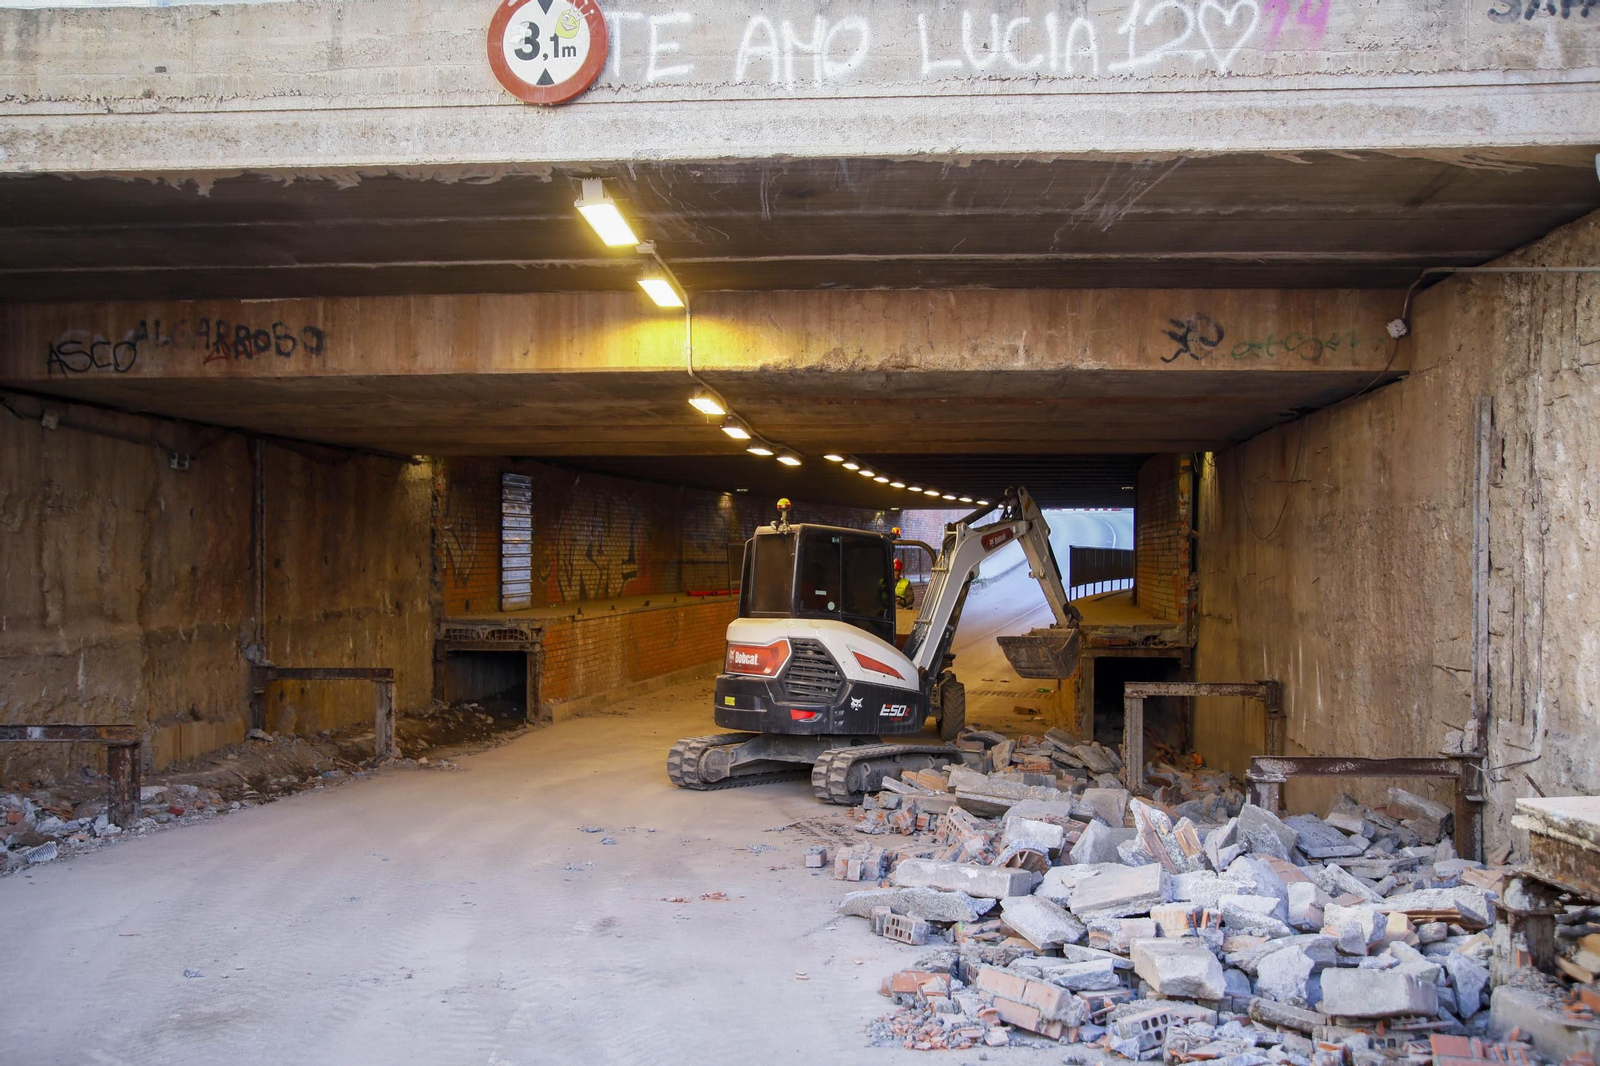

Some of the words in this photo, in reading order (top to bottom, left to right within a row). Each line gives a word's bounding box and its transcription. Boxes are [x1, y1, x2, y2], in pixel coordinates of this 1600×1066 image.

[606, 11, 695, 84] TE
[917, 13, 1099, 76] LUCIA
[46, 340, 138, 377] ASCO
[734, 652, 759, 666] Bobcat
